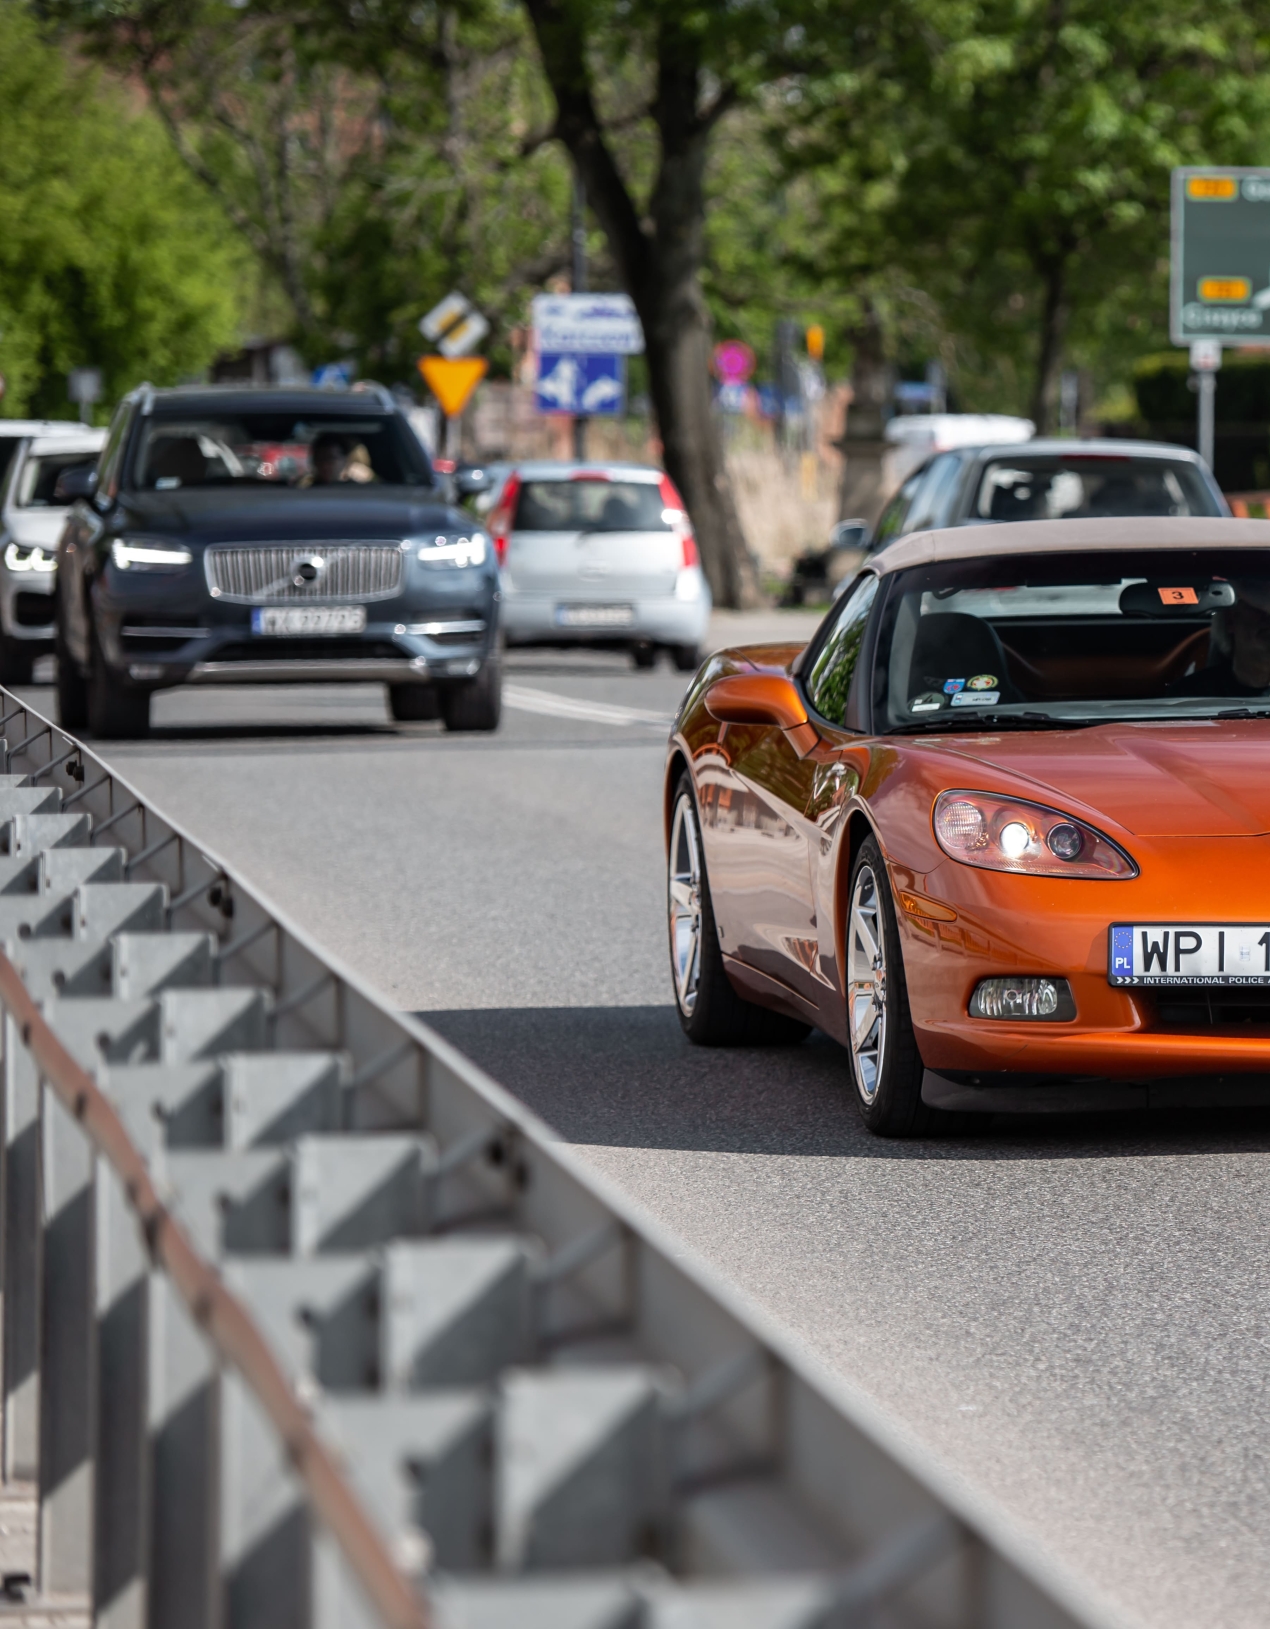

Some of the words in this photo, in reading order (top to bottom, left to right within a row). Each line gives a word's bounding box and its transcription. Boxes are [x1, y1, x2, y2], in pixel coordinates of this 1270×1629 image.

[1172, 591, 1184, 600] 3
[1115, 957, 1130, 969] PL
[1143, 976, 1225, 984] INTERNATIONAL
[1228, 976, 1264, 984] POLICE
